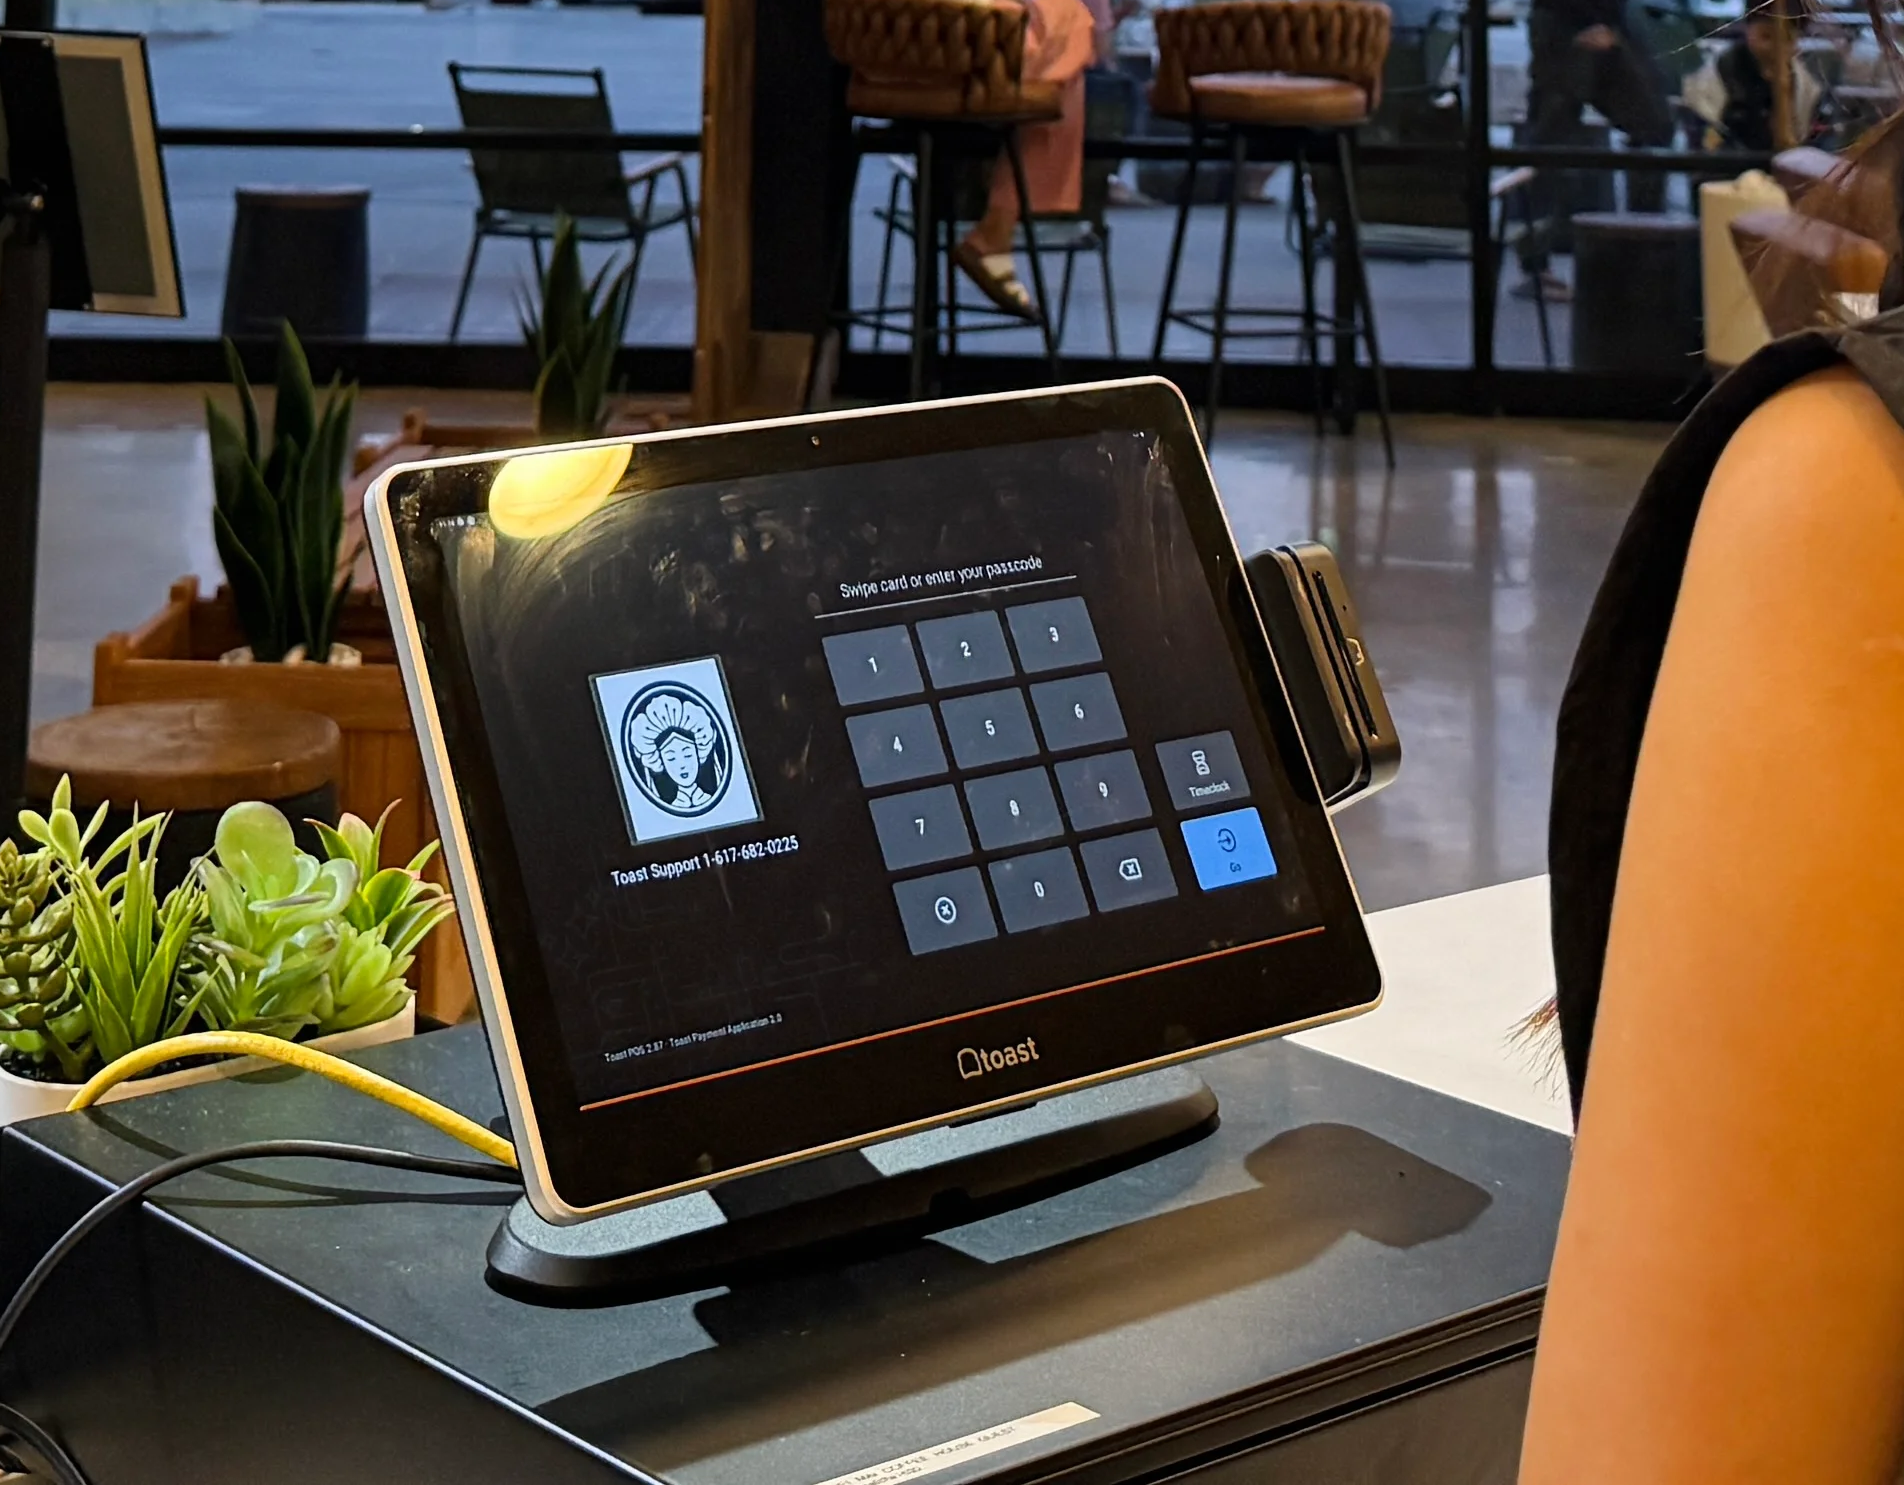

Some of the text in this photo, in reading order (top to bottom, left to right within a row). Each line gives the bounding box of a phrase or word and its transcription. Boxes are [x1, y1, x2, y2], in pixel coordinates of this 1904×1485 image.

[840, 555, 1042, 598] Swipe card or enter your passcode
[1049, 626, 1060, 642] 3
[960, 641, 972, 657] 2
[868, 657, 878, 673] 1
[1074, 703, 1085, 719] 6
[985, 719, 996, 736] 5
[893, 735, 904, 752] 4
[1099, 781, 1109, 798] 9
[1009, 800, 1020, 816] 8
[915, 818, 925, 836] 7
[610, 834, 800, 887] Toast Support 1-617-682-0225
[1034, 881, 1045, 898] 0
[604, 1050, 627, 1062] Toast
[628, 1044, 646, 1057] POS
[692, 1026, 727, 1042] Payment
[980, 1036, 1040, 1072] toast
